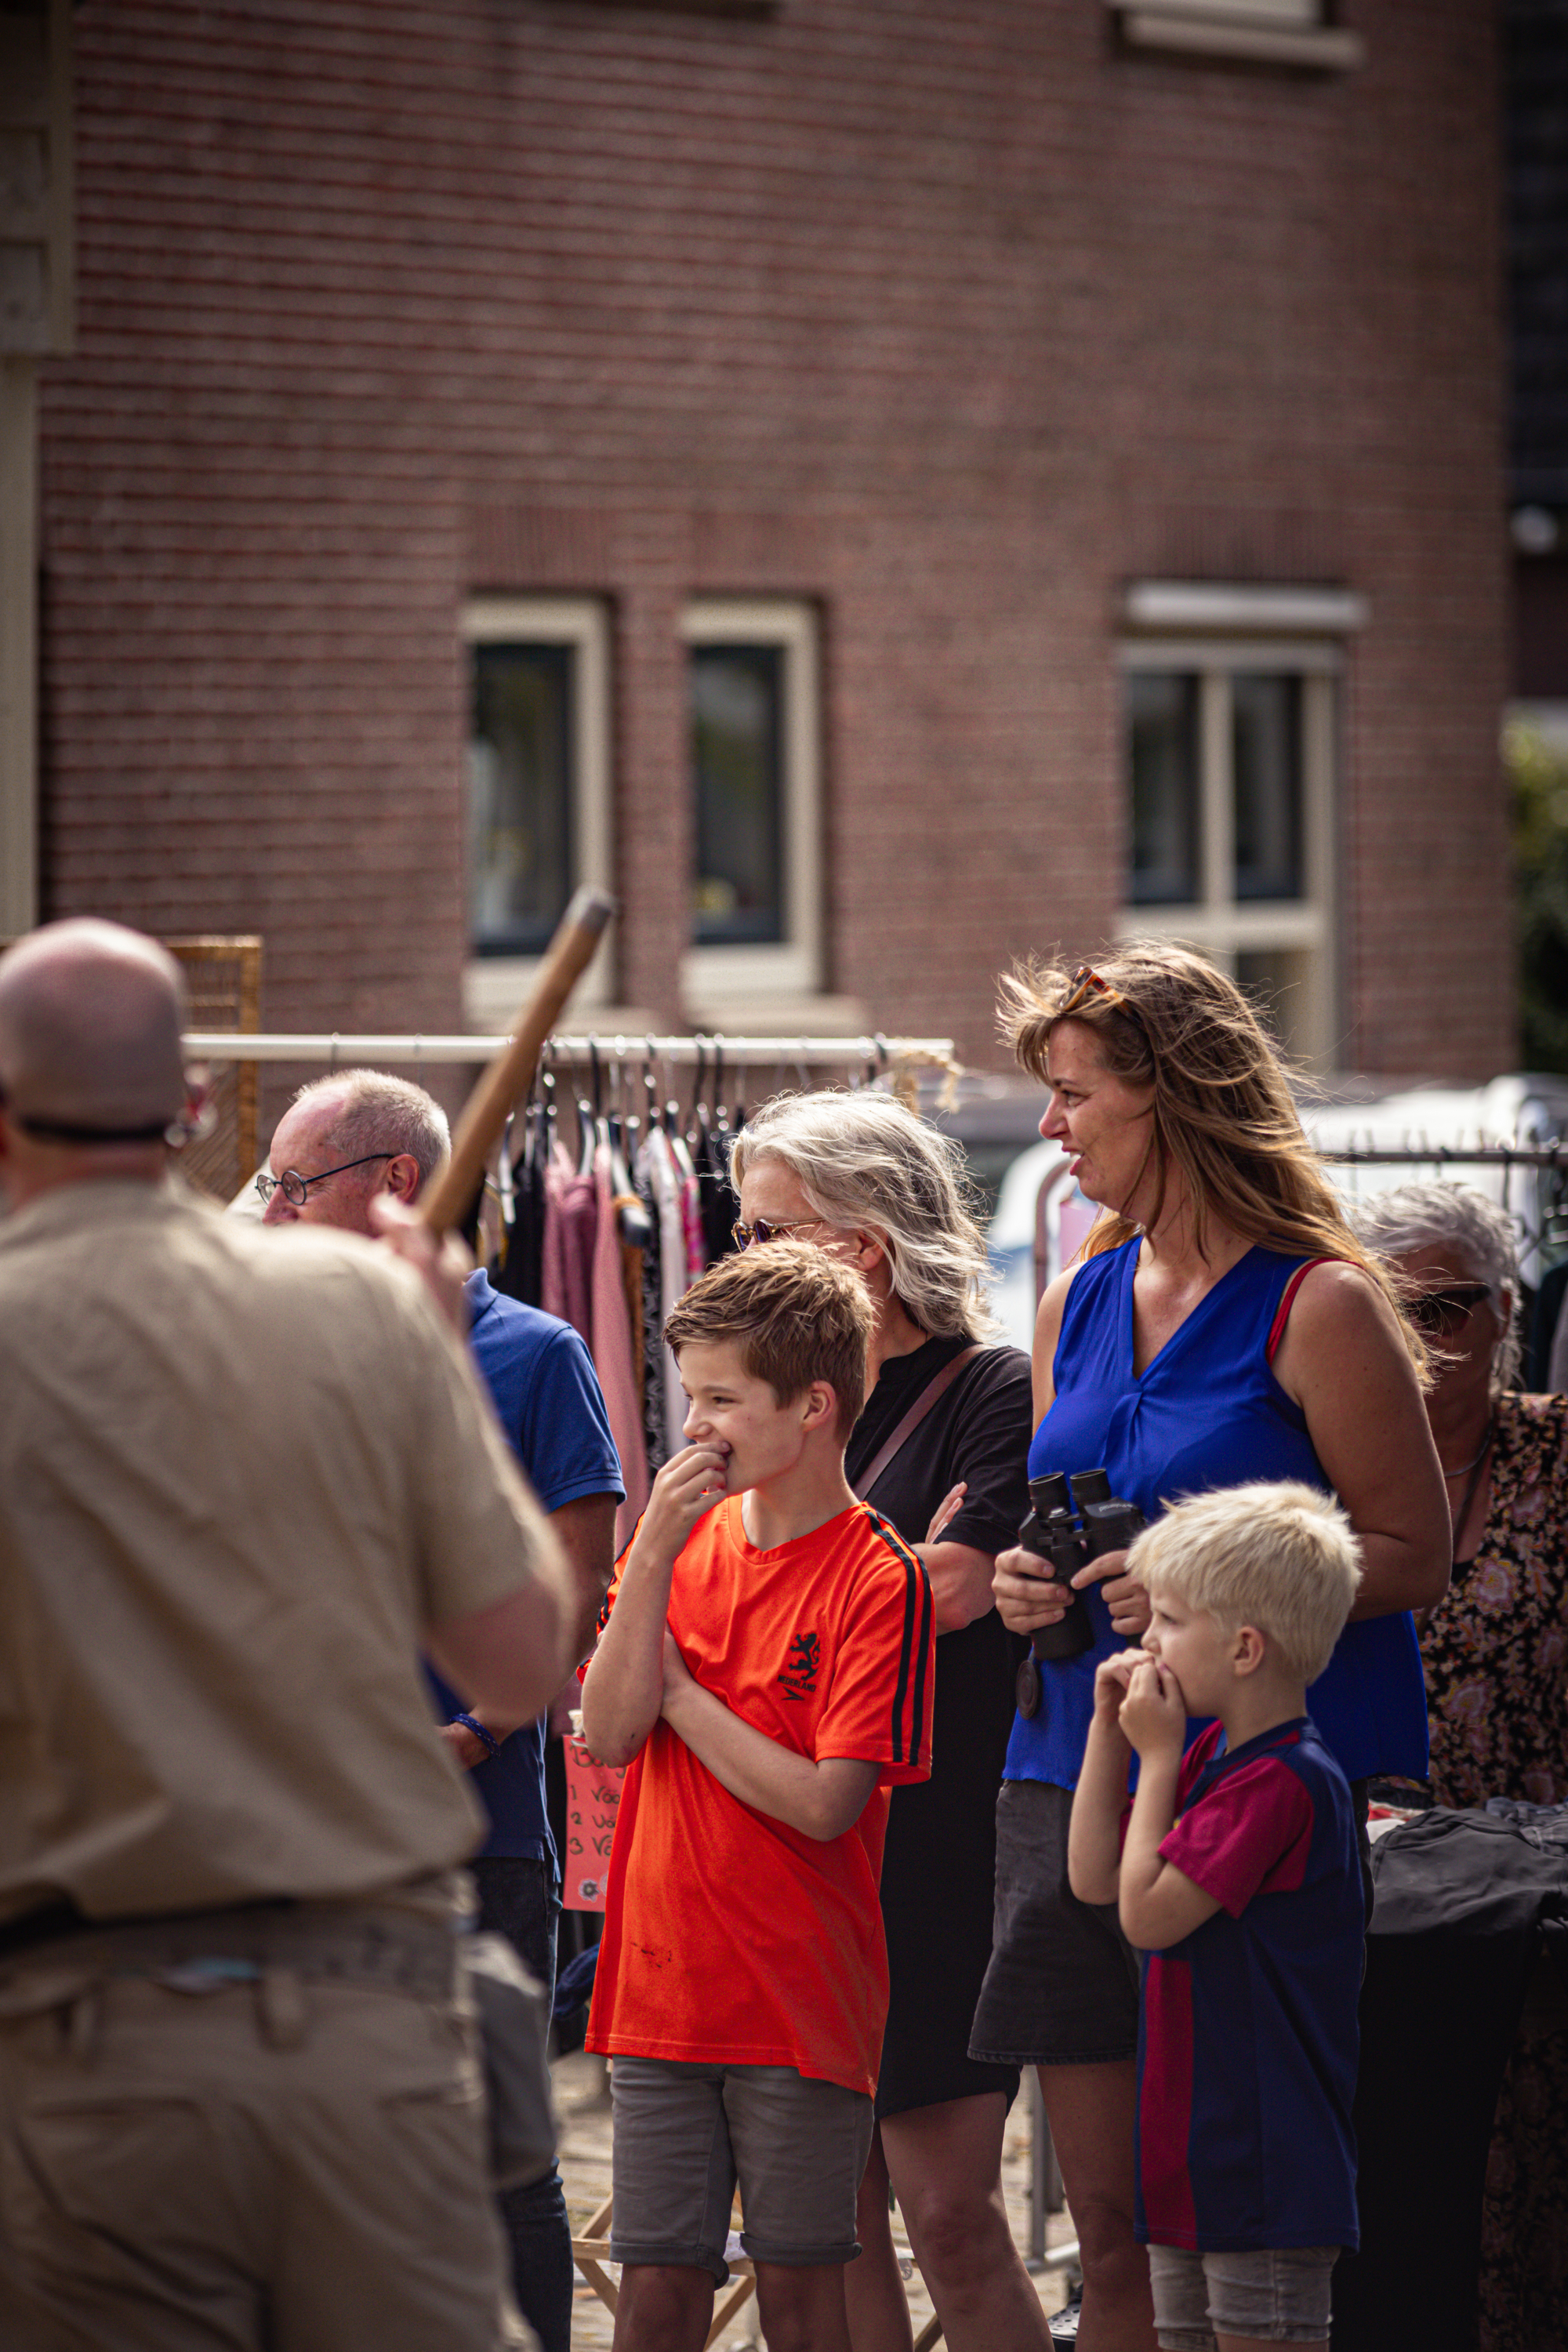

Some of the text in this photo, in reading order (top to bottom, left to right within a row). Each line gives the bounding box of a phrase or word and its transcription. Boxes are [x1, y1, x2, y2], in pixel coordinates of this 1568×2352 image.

[777, 1675, 816, 1693] NEDERLAND
[571, 1784, 577, 1801] 1
[571, 1812, 582, 1825] 2
[569, 1837, 583, 1856] 3
